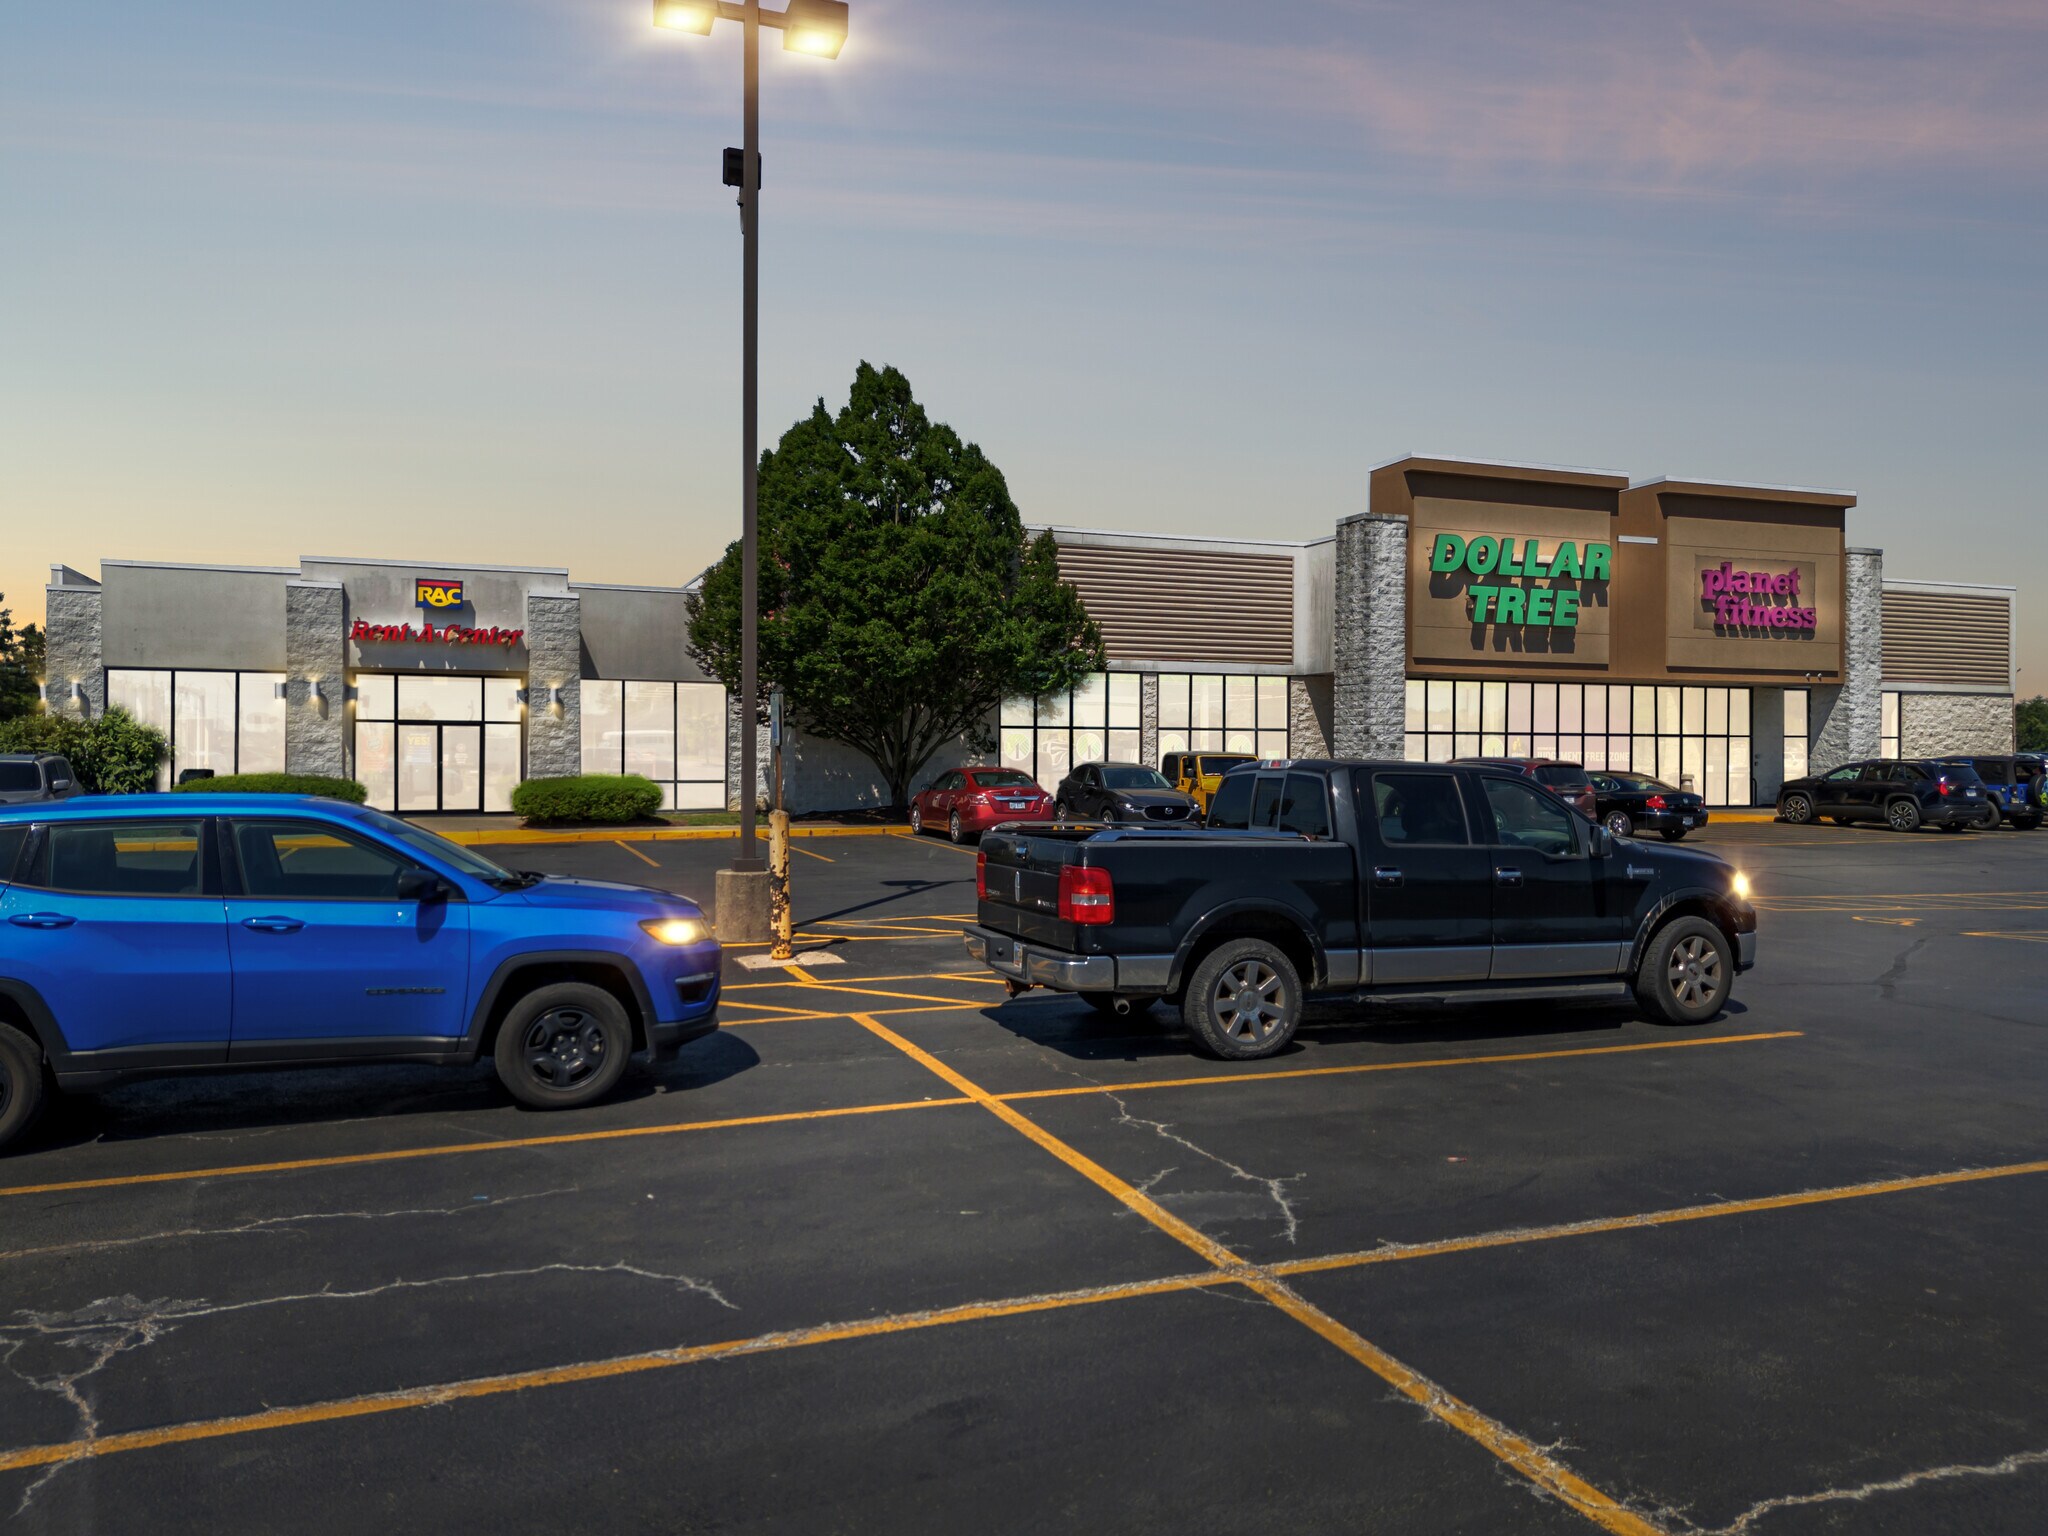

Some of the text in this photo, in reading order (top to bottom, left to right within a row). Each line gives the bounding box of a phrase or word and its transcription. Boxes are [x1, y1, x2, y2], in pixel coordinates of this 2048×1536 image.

[1429, 533, 1612, 580] DOLLAR
[417, 586, 462, 608] RAC
[1701, 561, 1801, 600] planet
[1467, 584, 1580, 627] TREE
[1714, 594, 1818, 629] fitness
[1585, 751, 1605, 761] FREE
[1609, 751, 1630, 761] ZONE
